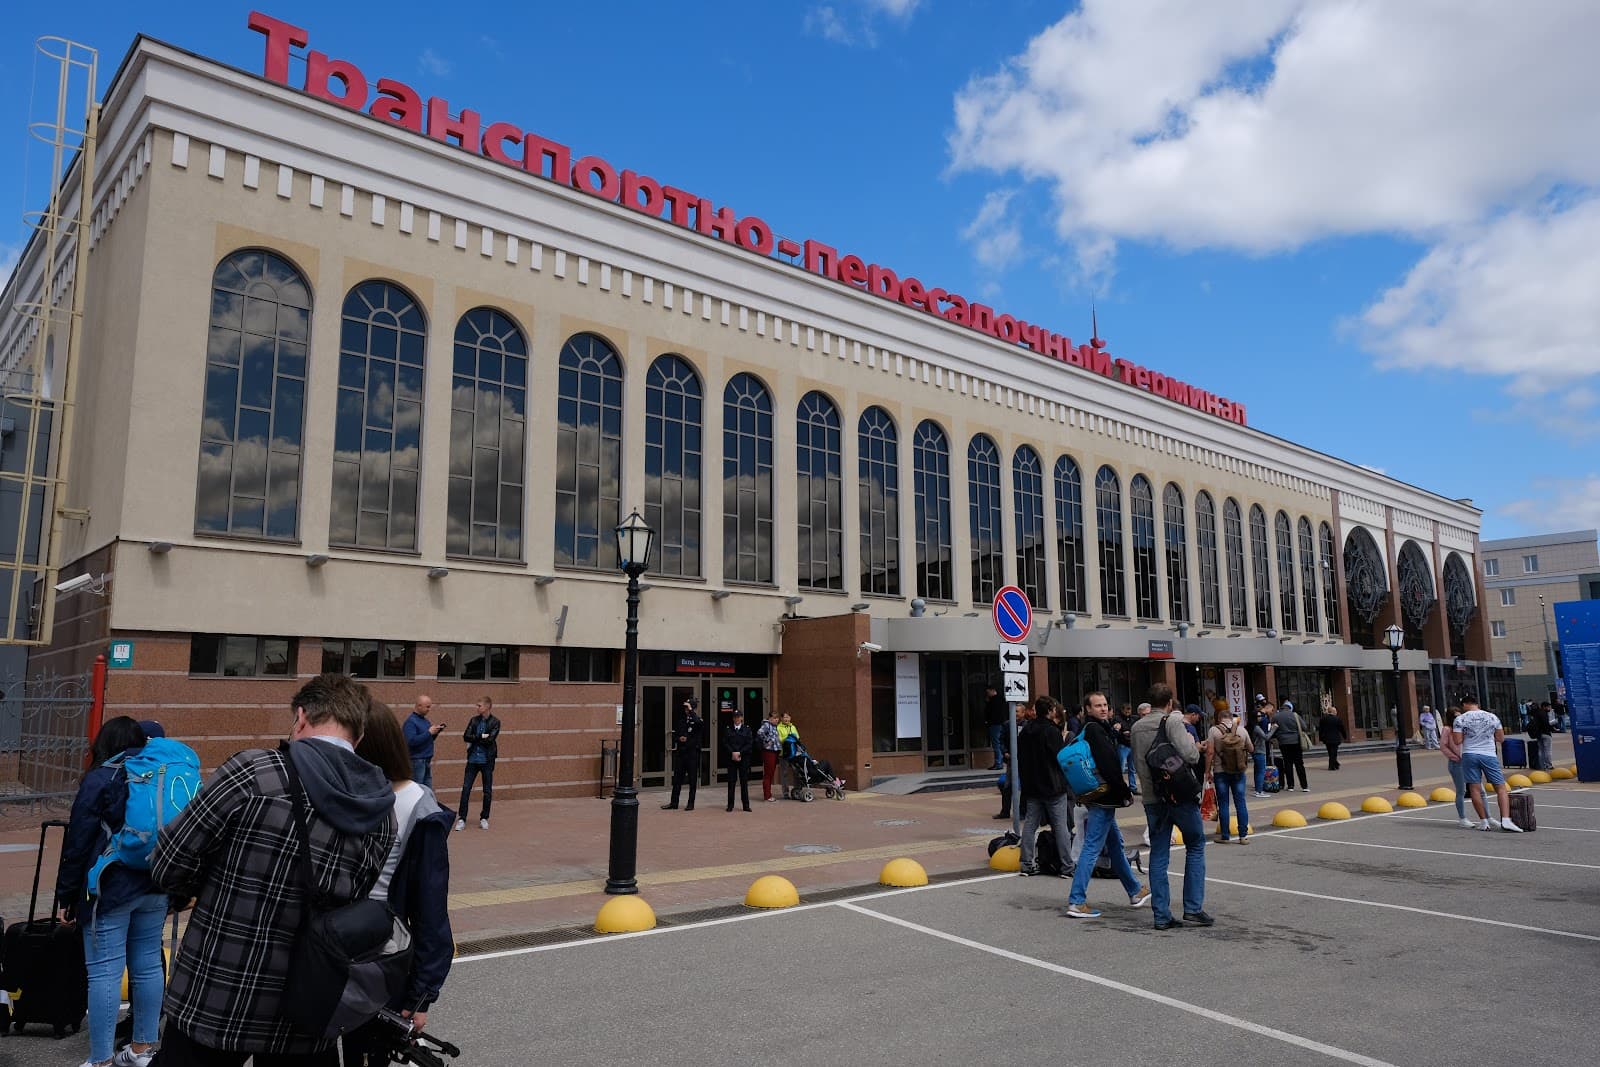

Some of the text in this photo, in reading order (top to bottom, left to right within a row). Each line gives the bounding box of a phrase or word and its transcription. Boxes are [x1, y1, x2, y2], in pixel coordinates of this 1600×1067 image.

[248, 11, 1247, 417] Транспортно-пересадочный терминал
[1231, 674, 1241, 713] SOUVE
